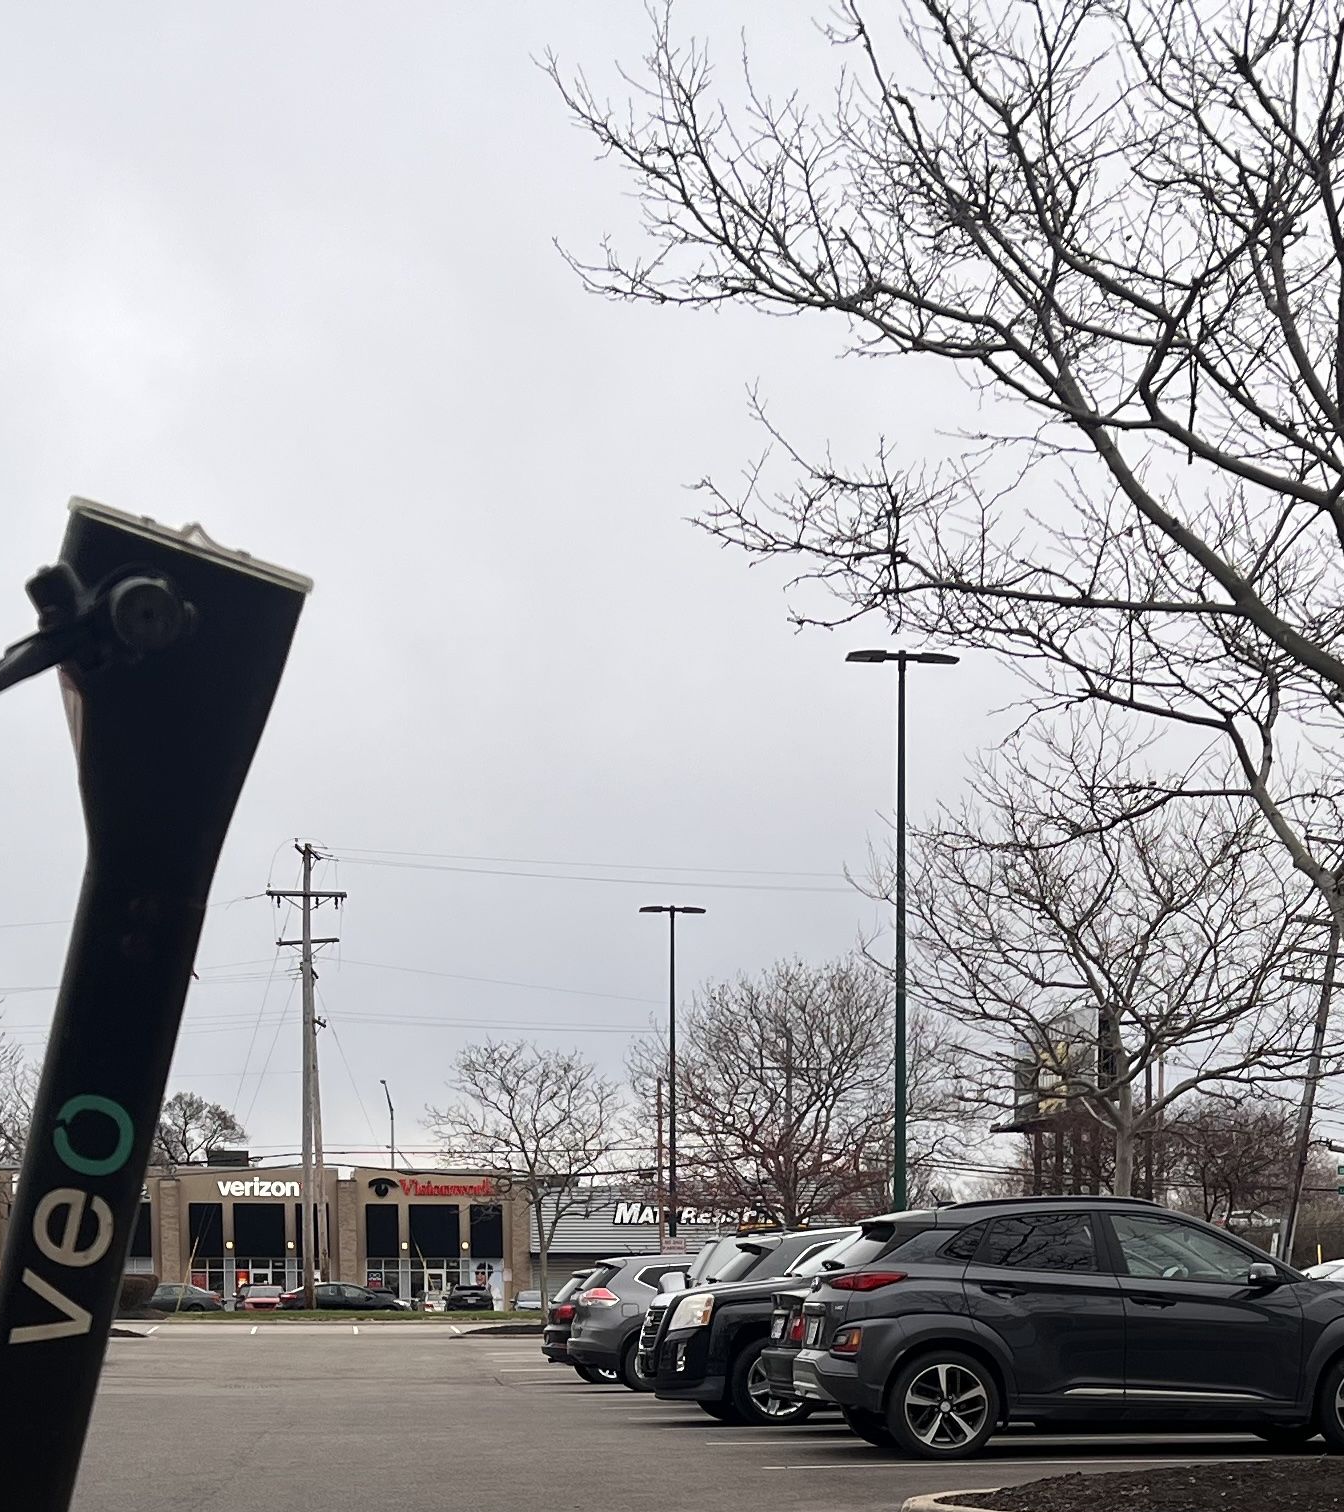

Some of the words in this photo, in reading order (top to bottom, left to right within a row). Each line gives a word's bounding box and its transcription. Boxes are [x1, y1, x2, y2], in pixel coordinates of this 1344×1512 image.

[217, 1176, 300, 1197] verizon
[9, 1094, 134, 1344] veo
[613, 1202, 740, 1224] MATRESS
